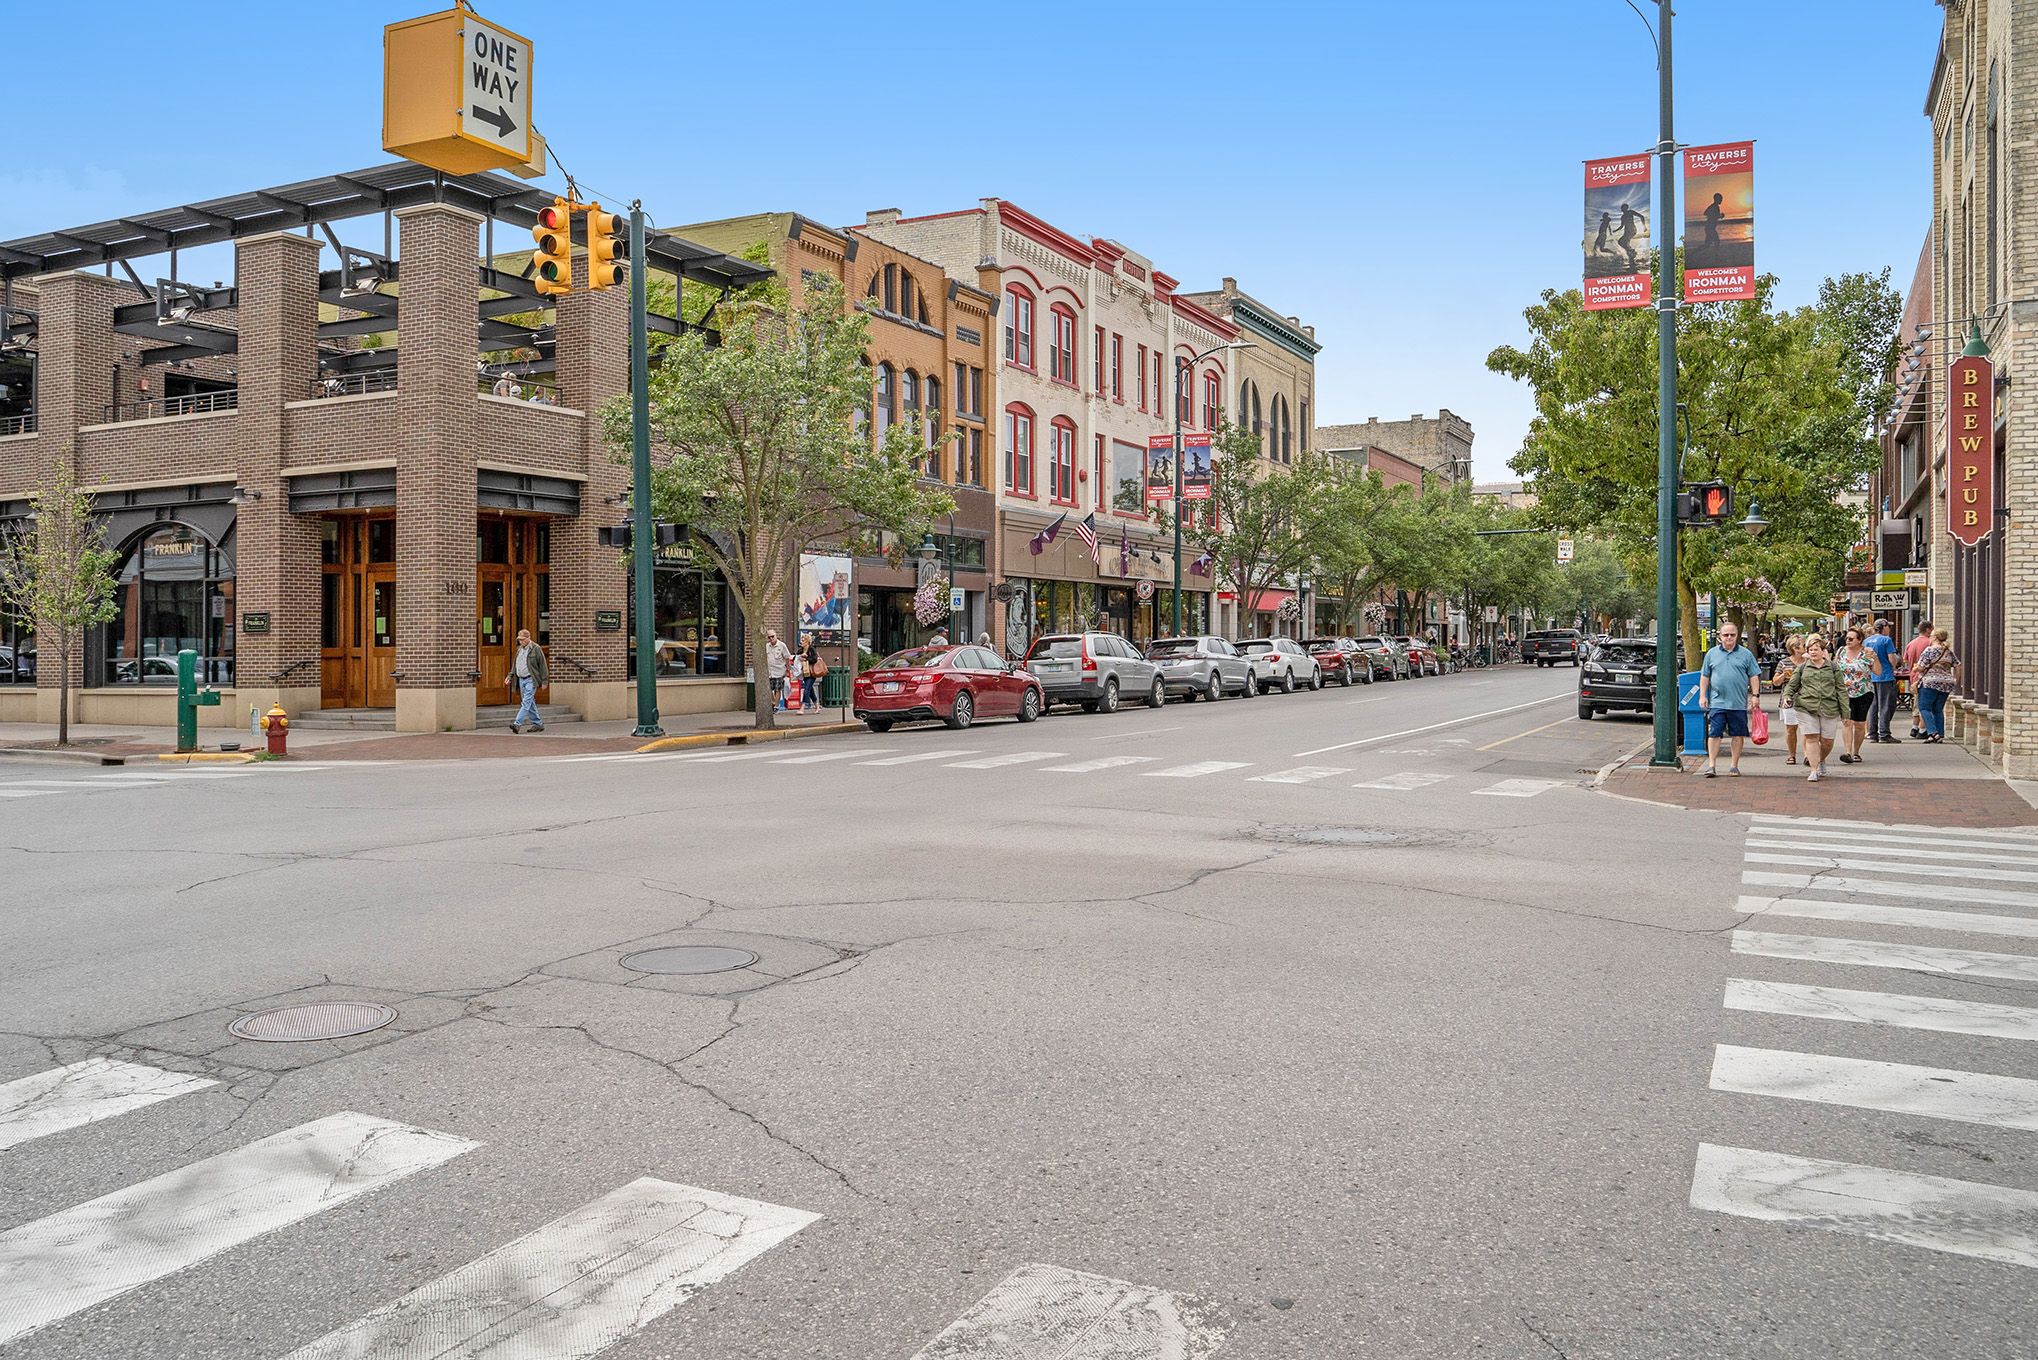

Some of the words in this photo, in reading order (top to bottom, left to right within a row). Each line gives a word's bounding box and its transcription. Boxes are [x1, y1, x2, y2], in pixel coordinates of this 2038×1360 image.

[475, 31, 517, 73] ONE
[473, 61, 519, 103] WAY
[1690, 149, 1747, 162] TRAVERSE
[1591, 161, 1645, 174] TRAVERSE
[1691, 160, 1747, 172] city
[1592, 170, 1645, 184] city
[1697, 268, 1738, 276] WELCOMES
[1596, 275, 1636, 284] WELCOMES
[1688, 275, 1746, 288] IRONMAN
[1588, 283, 1643, 296] IRONMAN
[1692, 286, 1744, 296] COMPETITORS
[1592, 294, 1641, 304] COMPETITORS
[1958, 369, 1983, 452] BREW
[1962, 465, 1979, 526] PUB
[154, 543, 193, 556] FRANKLIN
